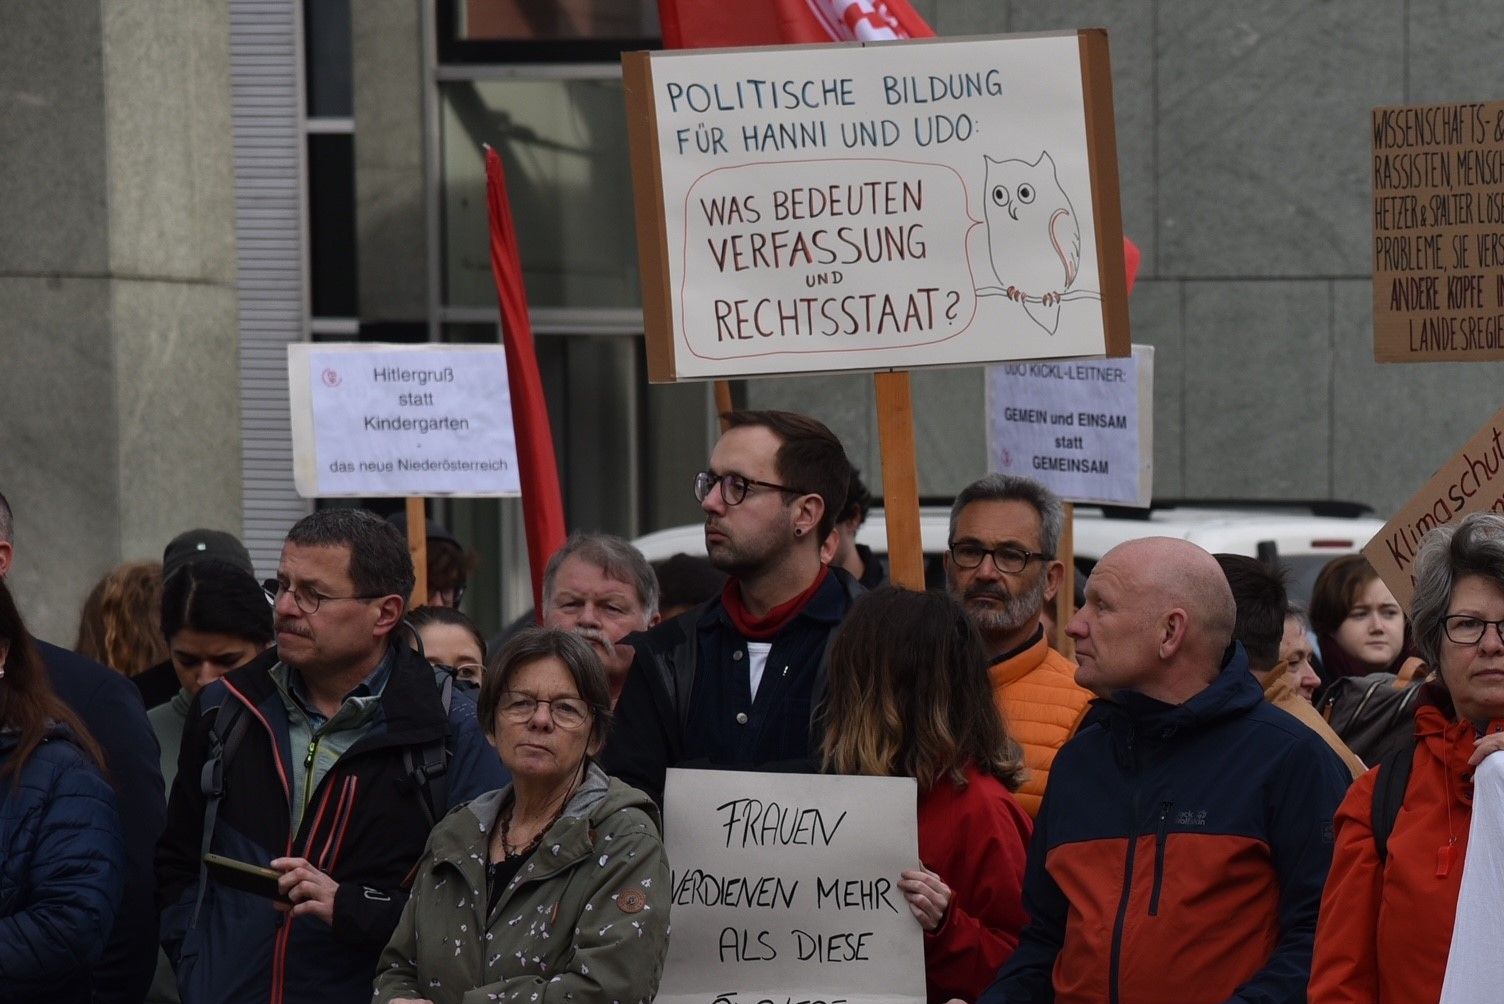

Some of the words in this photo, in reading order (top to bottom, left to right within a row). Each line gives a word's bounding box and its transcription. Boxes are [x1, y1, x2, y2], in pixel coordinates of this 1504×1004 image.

[667, 78, 855, 113] POLITISCHE
[884, 69, 1003, 105] BILDUNG
[677, 123, 728, 155] FÜR
[742, 121, 827, 152] HANNI
[841, 119, 900, 148] UND
[915, 114, 979, 147] UDO:
[1373, 104, 1490, 149] WISSENSCHAFTS-
[1494, 110, 1504, 143] &
[1374, 152, 1454, 191] RASSISTEN,
[700, 194, 761, 227] WAS
[773, 179, 923, 221] BEDEUTEN
[1375, 196, 1418, 230] HETZER
[1420, 204, 1427, 227] &
[1429, 193, 1473, 227] SPALTER
[708, 224, 926, 273] VERFASSUNG
[1376, 234, 1447, 272] PROBLEME,
[1452, 235, 1469, 269] SIE
[806, 271, 844, 288] UND
[1390, 277, 1440, 311] ANDERE
[373, 367, 454, 384] Hitlergruß
[398, 392, 433, 406] statt
[364, 416, 469, 434] Kindergarten
[1004, 407, 1047, 424] GEMEIN
[1051, 412, 1073, 426] und
[1078, 412, 1127, 429] EINSAM
[1055, 436, 1083, 449] statt
[330, 459, 355, 473] das
[360, 462, 393, 472] neue
[398, 458, 508, 472] Niederösterreich
[1032, 456, 1109, 474] GEMEINSAM
[717, 798, 847, 848] FRAUEN
[671, 869, 798, 909] VERDIENEN
[817, 877, 898, 913] MEHR
[719, 927, 777, 962] ALS
[792, 930, 874, 962] DIESE
